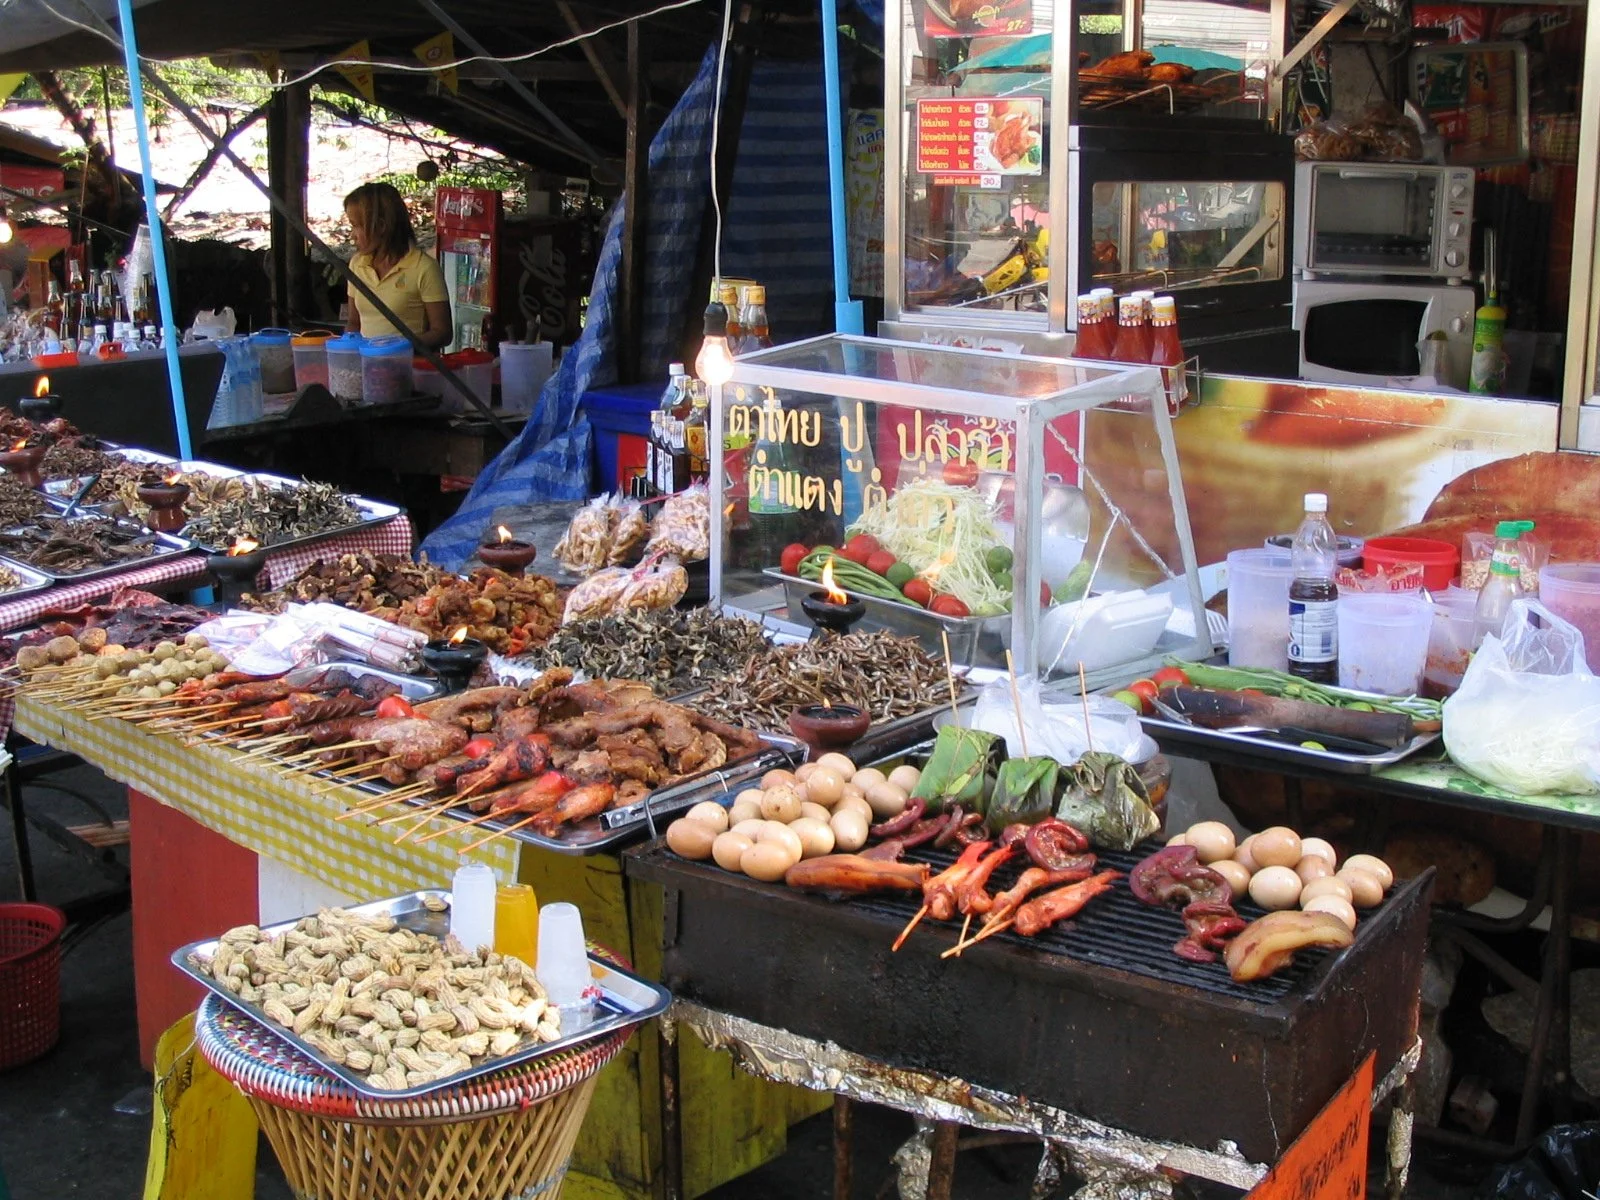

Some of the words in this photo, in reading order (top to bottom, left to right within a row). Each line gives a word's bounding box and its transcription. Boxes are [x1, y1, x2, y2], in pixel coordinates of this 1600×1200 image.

[730, 386, 820, 447] ตำไทย
[840, 401, 864, 473] ปู
[750, 449, 842, 516] ตำแตง
